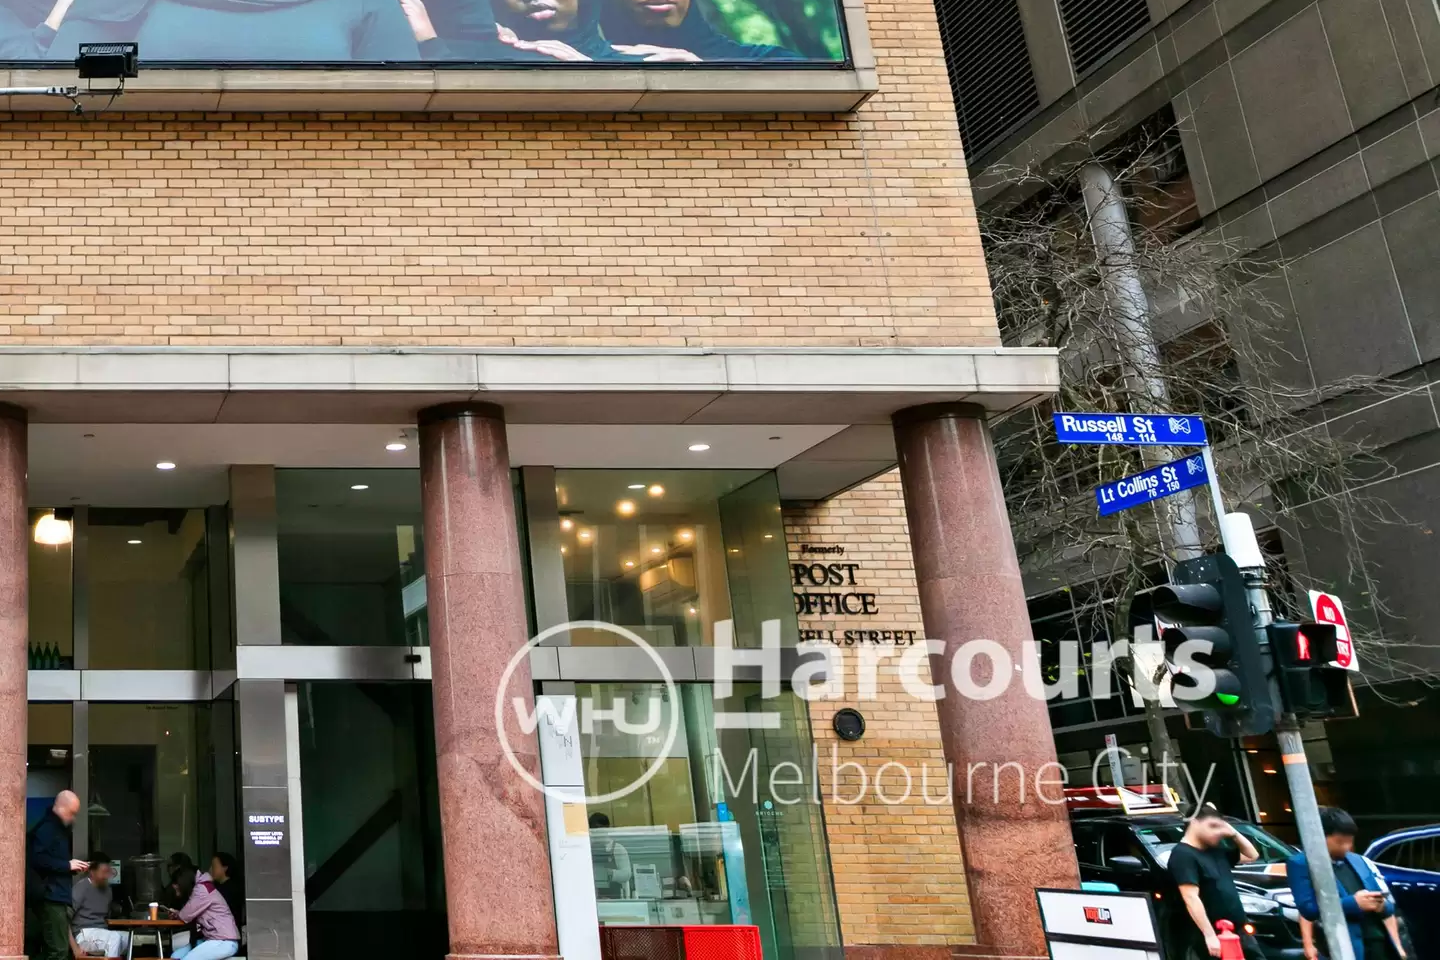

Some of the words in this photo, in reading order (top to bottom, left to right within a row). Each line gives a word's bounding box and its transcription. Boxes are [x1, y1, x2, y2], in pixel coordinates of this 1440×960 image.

[1062, 415, 1128, 433] Russell
[1133, 417, 1155, 434] St
[1105, 432, 1124, 442] 148
[1139, 433, 1157, 442] 114
[1100, 488, 1114, 504] Lt
[1117, 474, 1159, 498] Collins
[1161, 466, 1178, 482] St
[1147, 489, 1157, 498] 76
[1167, 480, 1180, 492] 150
[801, 544, 845, 556] Formerly
[790, 563, 860, 586] POST
[1322, 605, 1337, 622] NO
[844, 630, 917, 646] STREET
[248, 815, 285, 823] SUBTYPE
